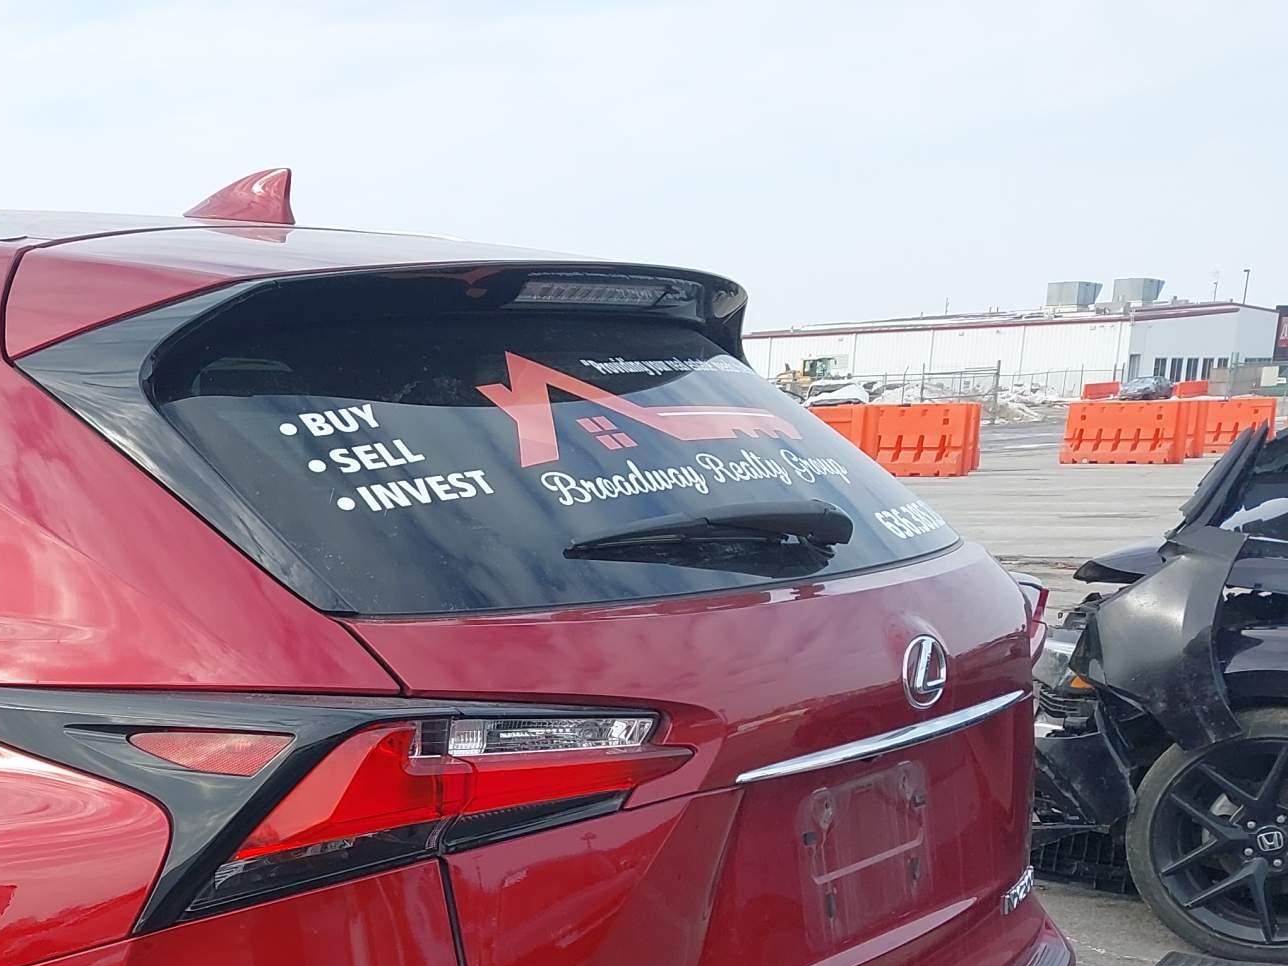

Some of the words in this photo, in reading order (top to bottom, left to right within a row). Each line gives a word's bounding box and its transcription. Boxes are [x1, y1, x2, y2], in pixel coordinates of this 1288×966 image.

[298, 403, 380, 437] BUY
[329, 439, 425, 473] SELL
[356, 469, 494, 512] INVEST
[541, 459, 709, 506] Broadway
[695, 449, 793, 485] Realty
[780, 449, 851, 484] Group
